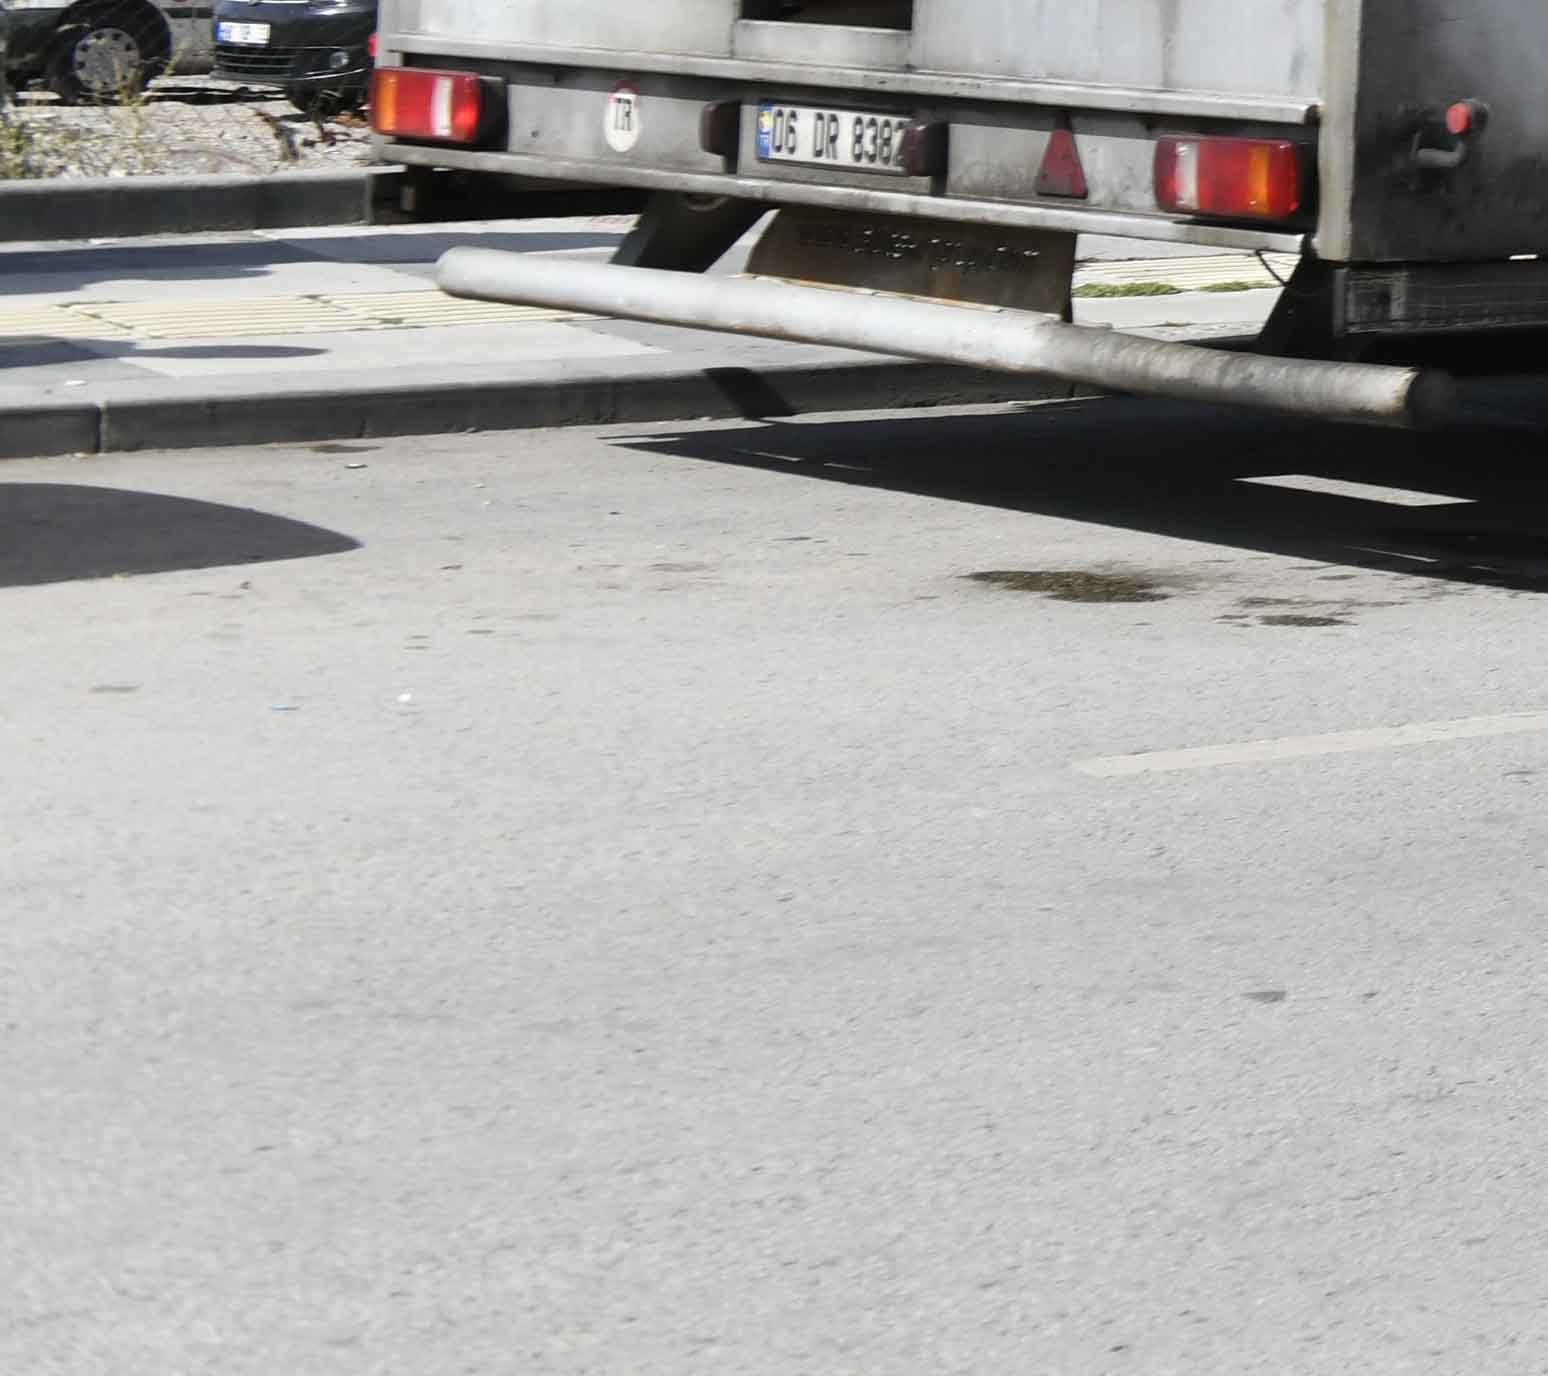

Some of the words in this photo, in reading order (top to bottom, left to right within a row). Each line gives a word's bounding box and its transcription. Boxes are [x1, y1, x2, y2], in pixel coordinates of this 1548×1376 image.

[615, 98, 632, 132] TR
[773, 109, 797, 155] 06
[814, 112, 839, 160] DR
